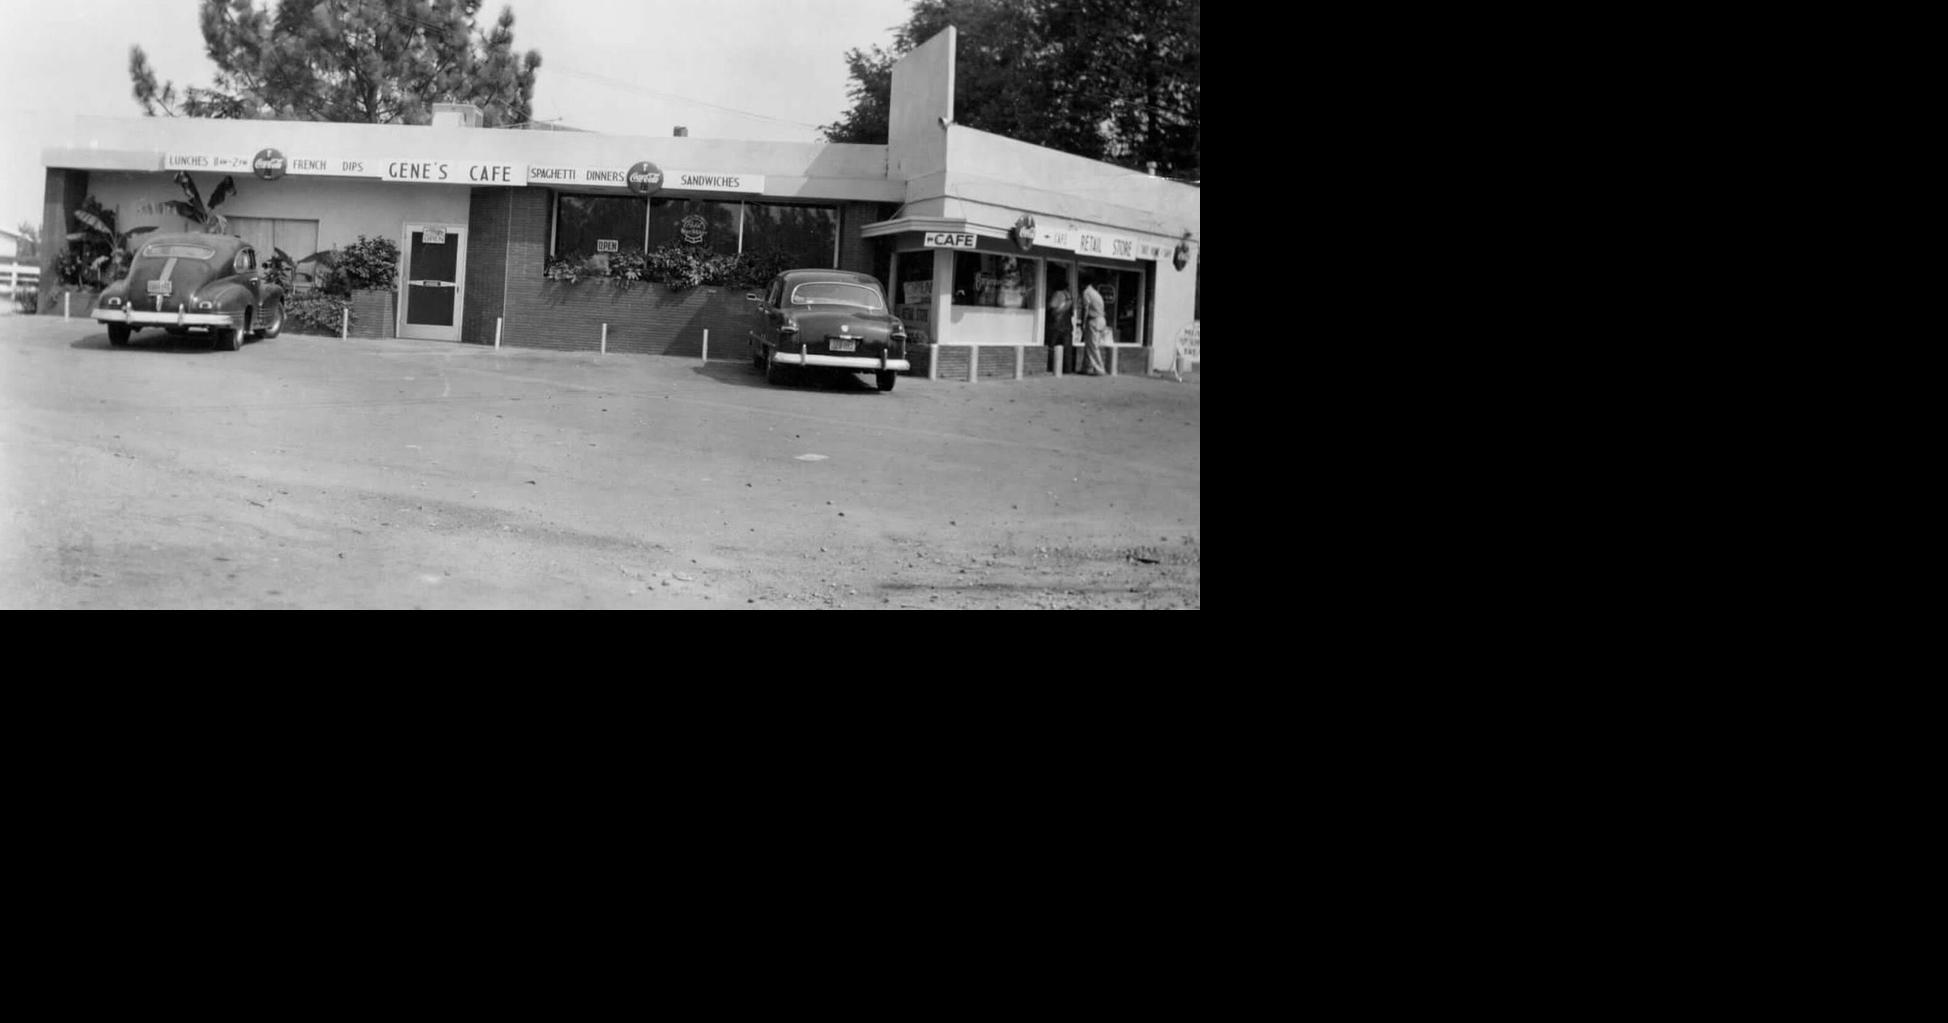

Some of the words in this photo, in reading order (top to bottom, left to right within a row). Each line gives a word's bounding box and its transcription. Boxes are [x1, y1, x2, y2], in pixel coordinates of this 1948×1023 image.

[169, 155, 208, 167] LUNCHES
[293, 159, 327, 171] FRENCH
[342, 160, 364, 173] DIPS
[389, 162, 449, 180] GENE'S
[470, 165, 512, 183] CAFE
[531, 168, 576, 181] SPAGHETTI
[586, 170, 625, 183] DINNERS
[681, 174, 741, 189] SANDWICHES
[599, 241, 618, 250] OPEN
[934, 233, 975, 247] CAFE
[1080, 234, 1102, 254] RETAIL
[1112, 239, 1133, 257] STORE
